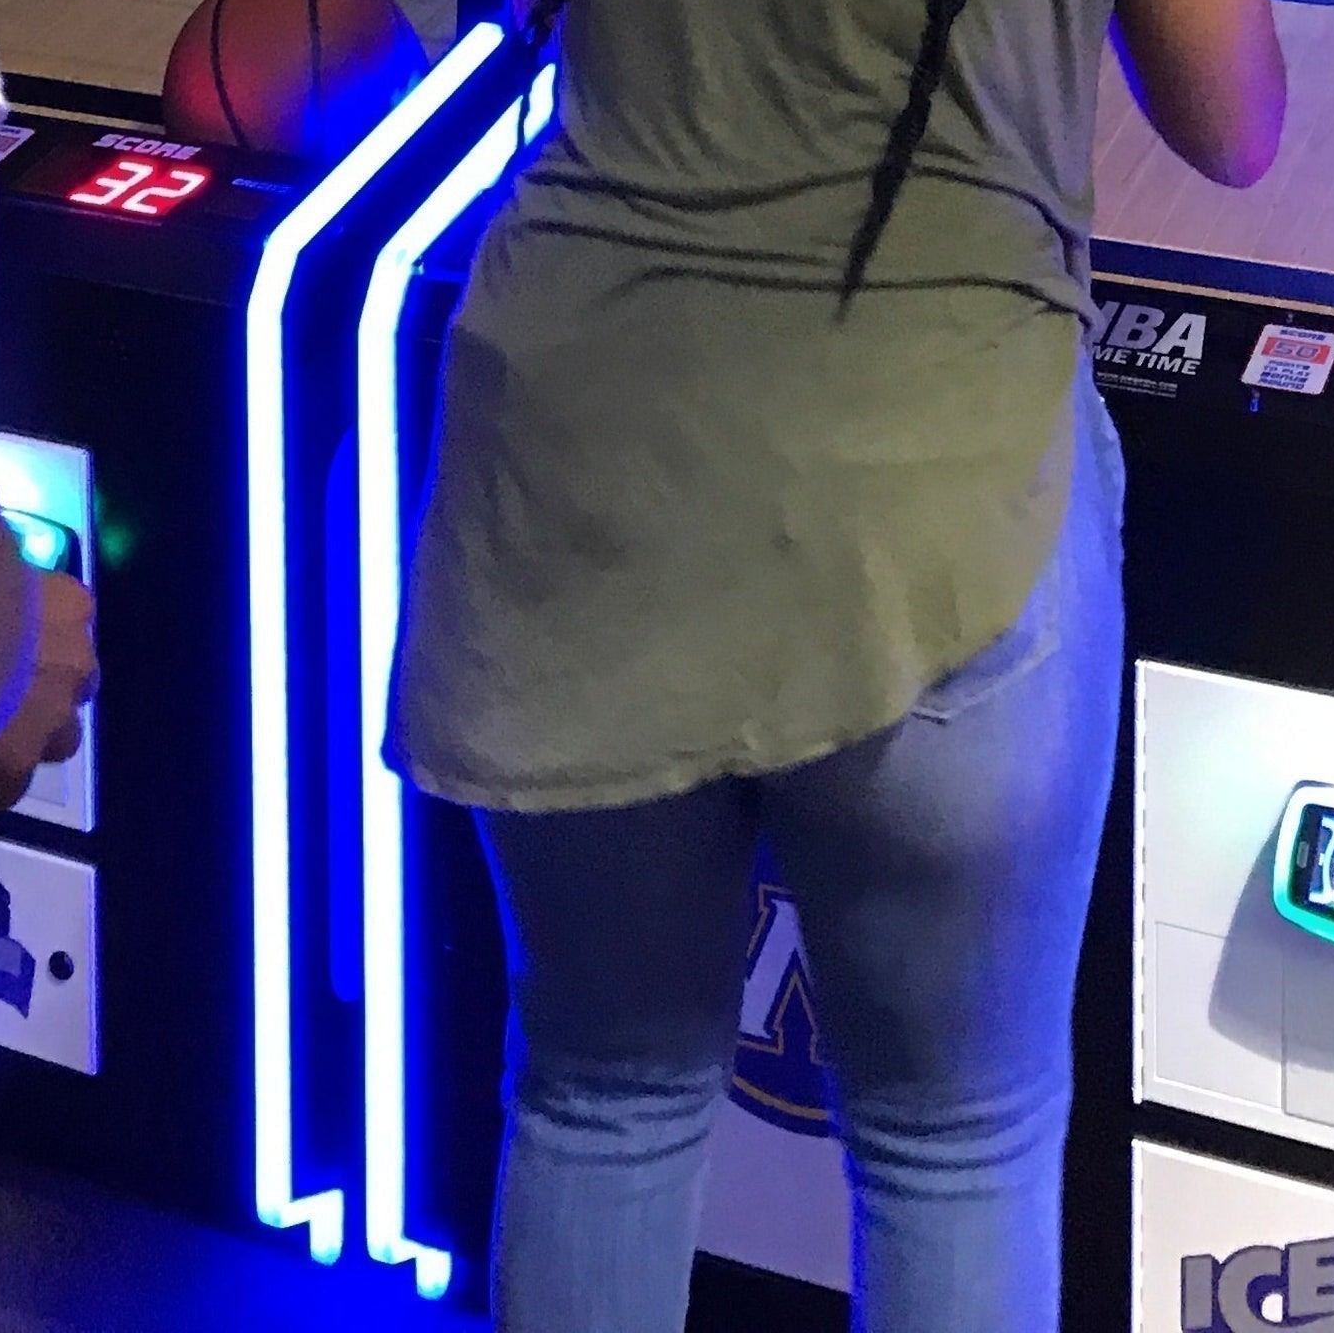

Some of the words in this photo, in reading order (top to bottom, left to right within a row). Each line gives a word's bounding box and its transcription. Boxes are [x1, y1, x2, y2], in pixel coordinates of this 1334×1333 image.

[92, 133, 202, 161] SCORE
[69, 161, 206, 215] 32
[1094, 345, 1132, 365] ME
[1135, 351, 1201, 376] TIME
